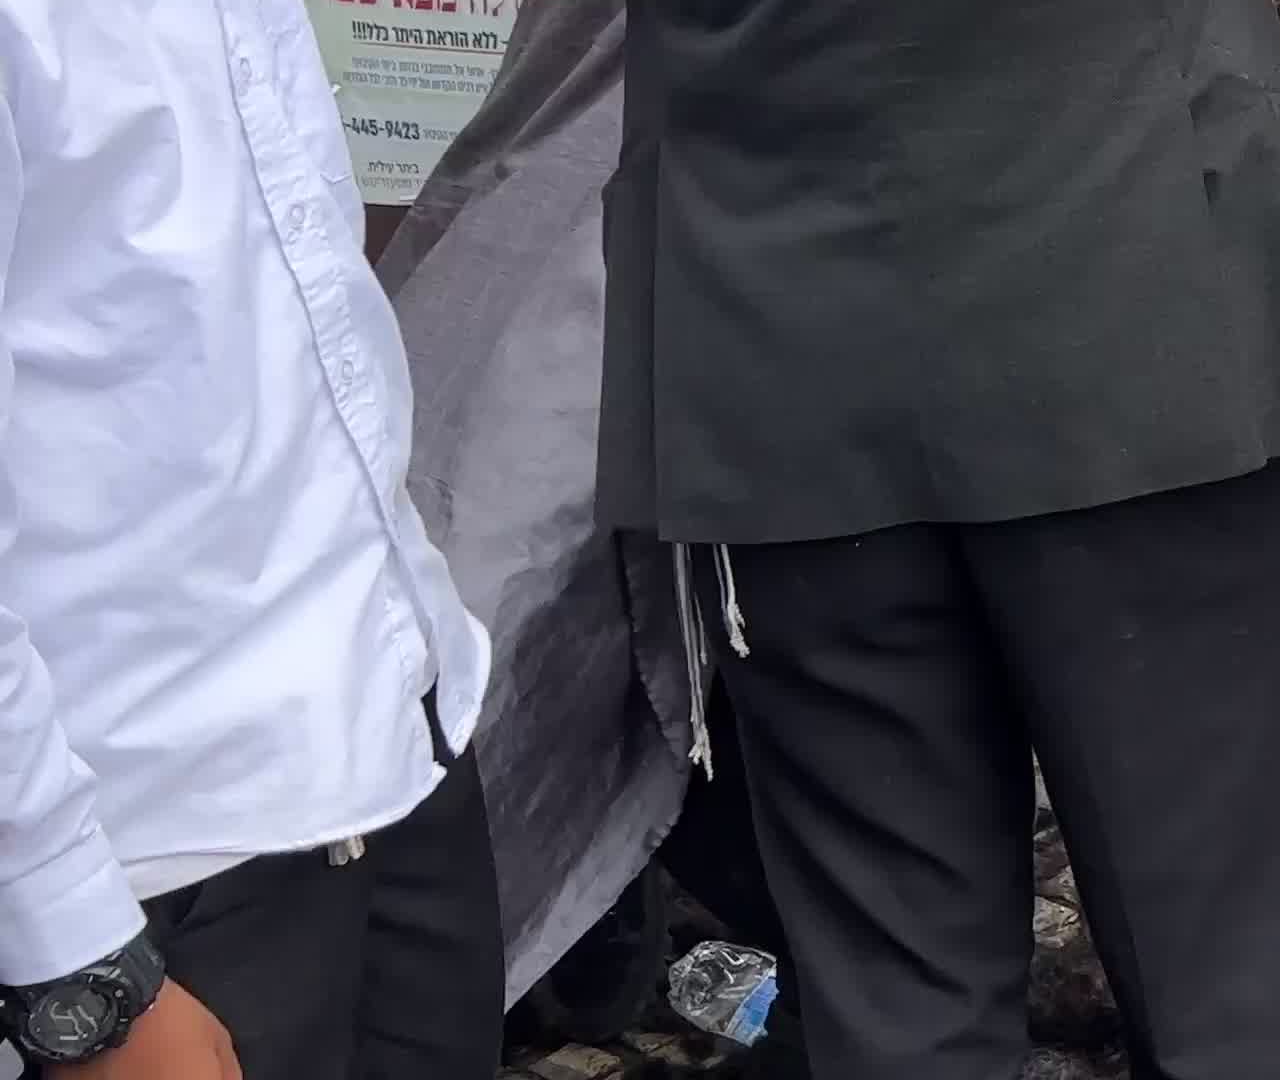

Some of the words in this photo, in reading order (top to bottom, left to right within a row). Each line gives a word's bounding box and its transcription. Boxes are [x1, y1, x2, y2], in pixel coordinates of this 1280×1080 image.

[392, 24, 423, 44] היתר
[426, 28, 469, 47] הוראת
[472, 31, 498, 50] ללא
[342, 117, 420, 140] -445-9423
